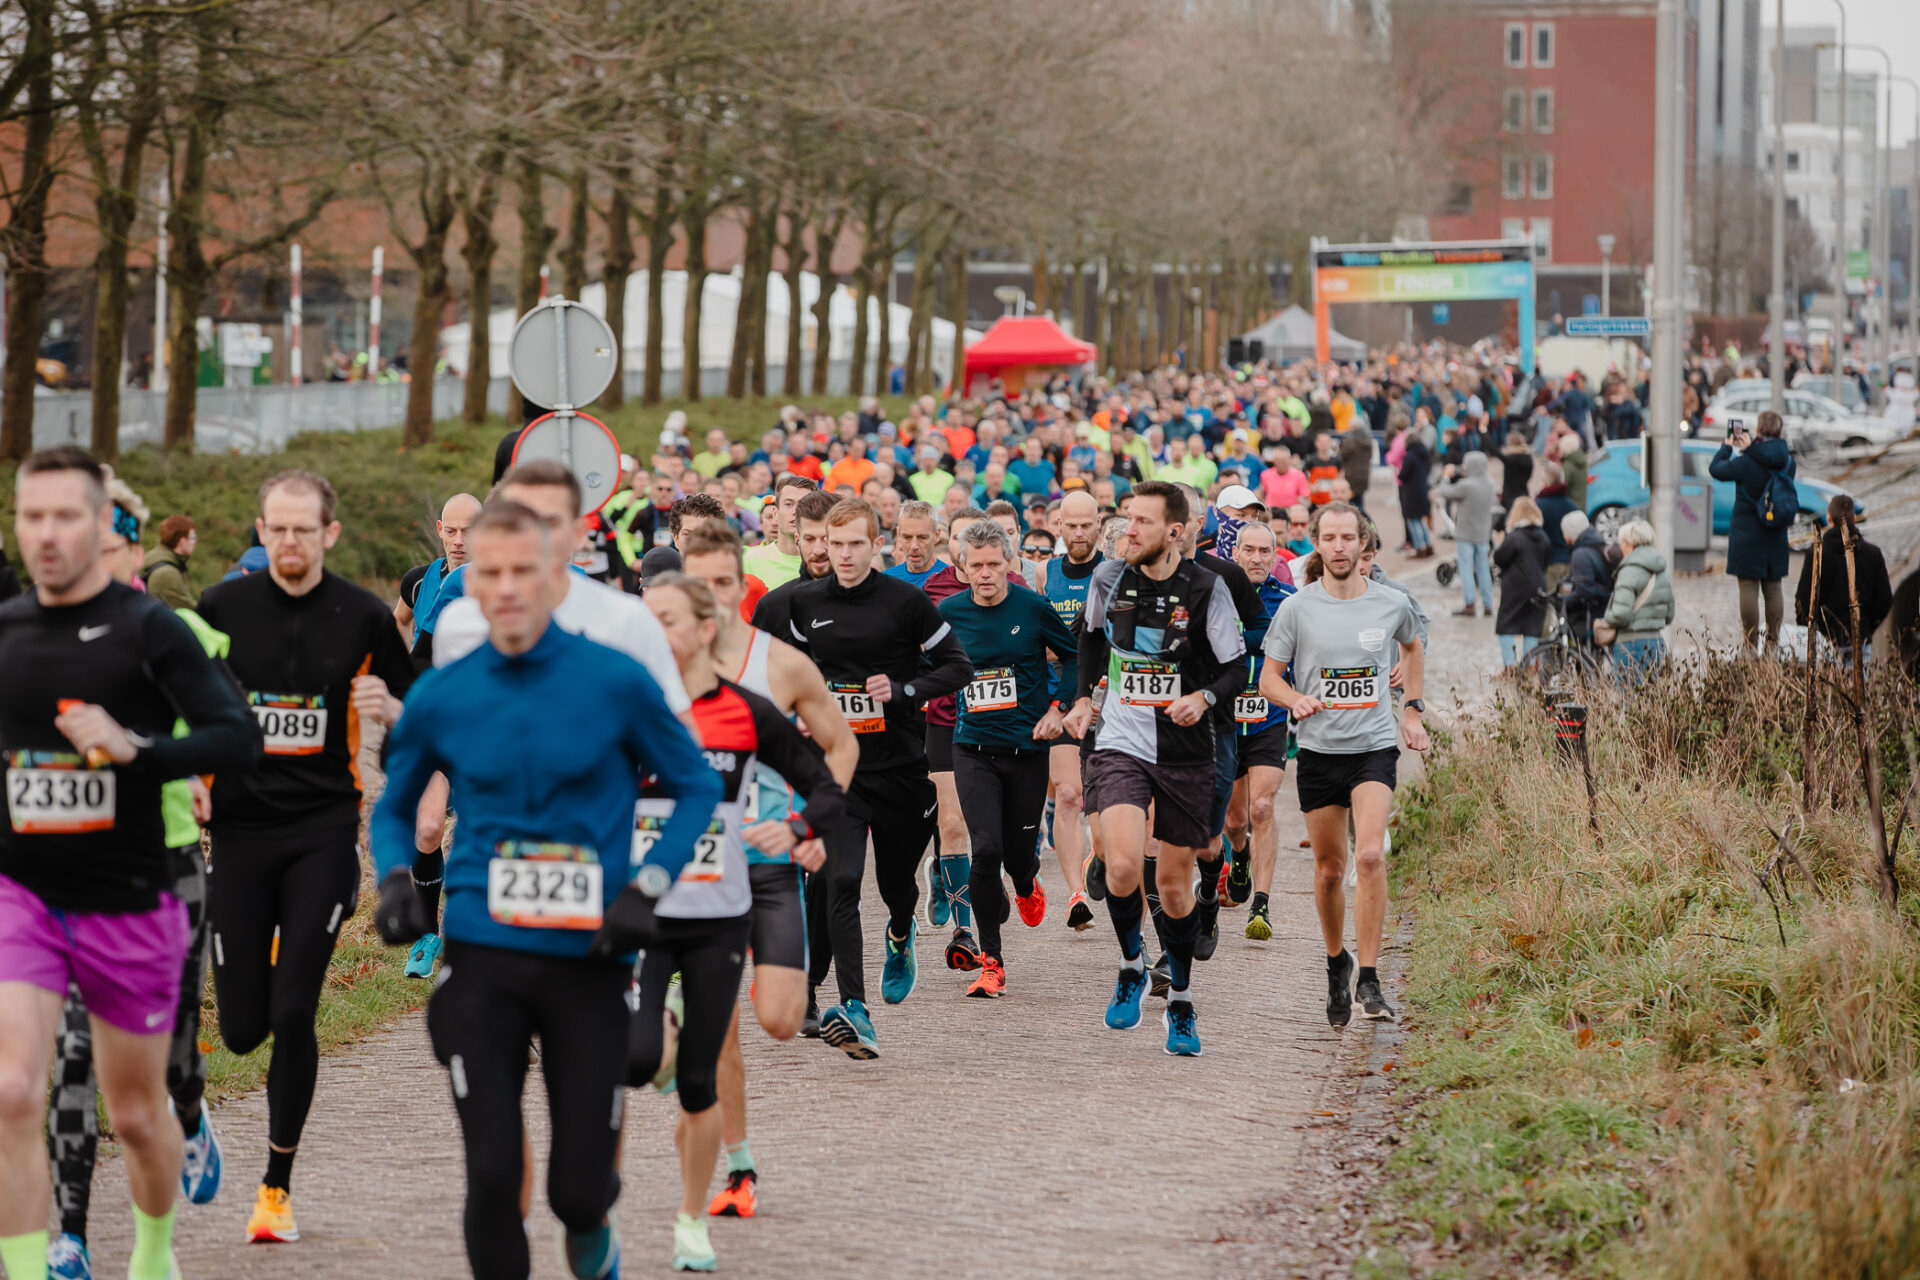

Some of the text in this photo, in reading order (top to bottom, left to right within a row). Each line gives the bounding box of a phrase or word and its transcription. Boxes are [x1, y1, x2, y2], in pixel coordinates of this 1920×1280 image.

[966, 680, 1012, 701] 4175
[1124, 675, 1175, 695] 4187
[1324, 679, 1374, 698] 2065
[837, 695, 875, 713] 161
[1237, 698, 1265, 713] 194
[264, 712, 318, 737] 089
[15, 777, 104, 808] 2330
[502, 869, 589, 903] 2329
